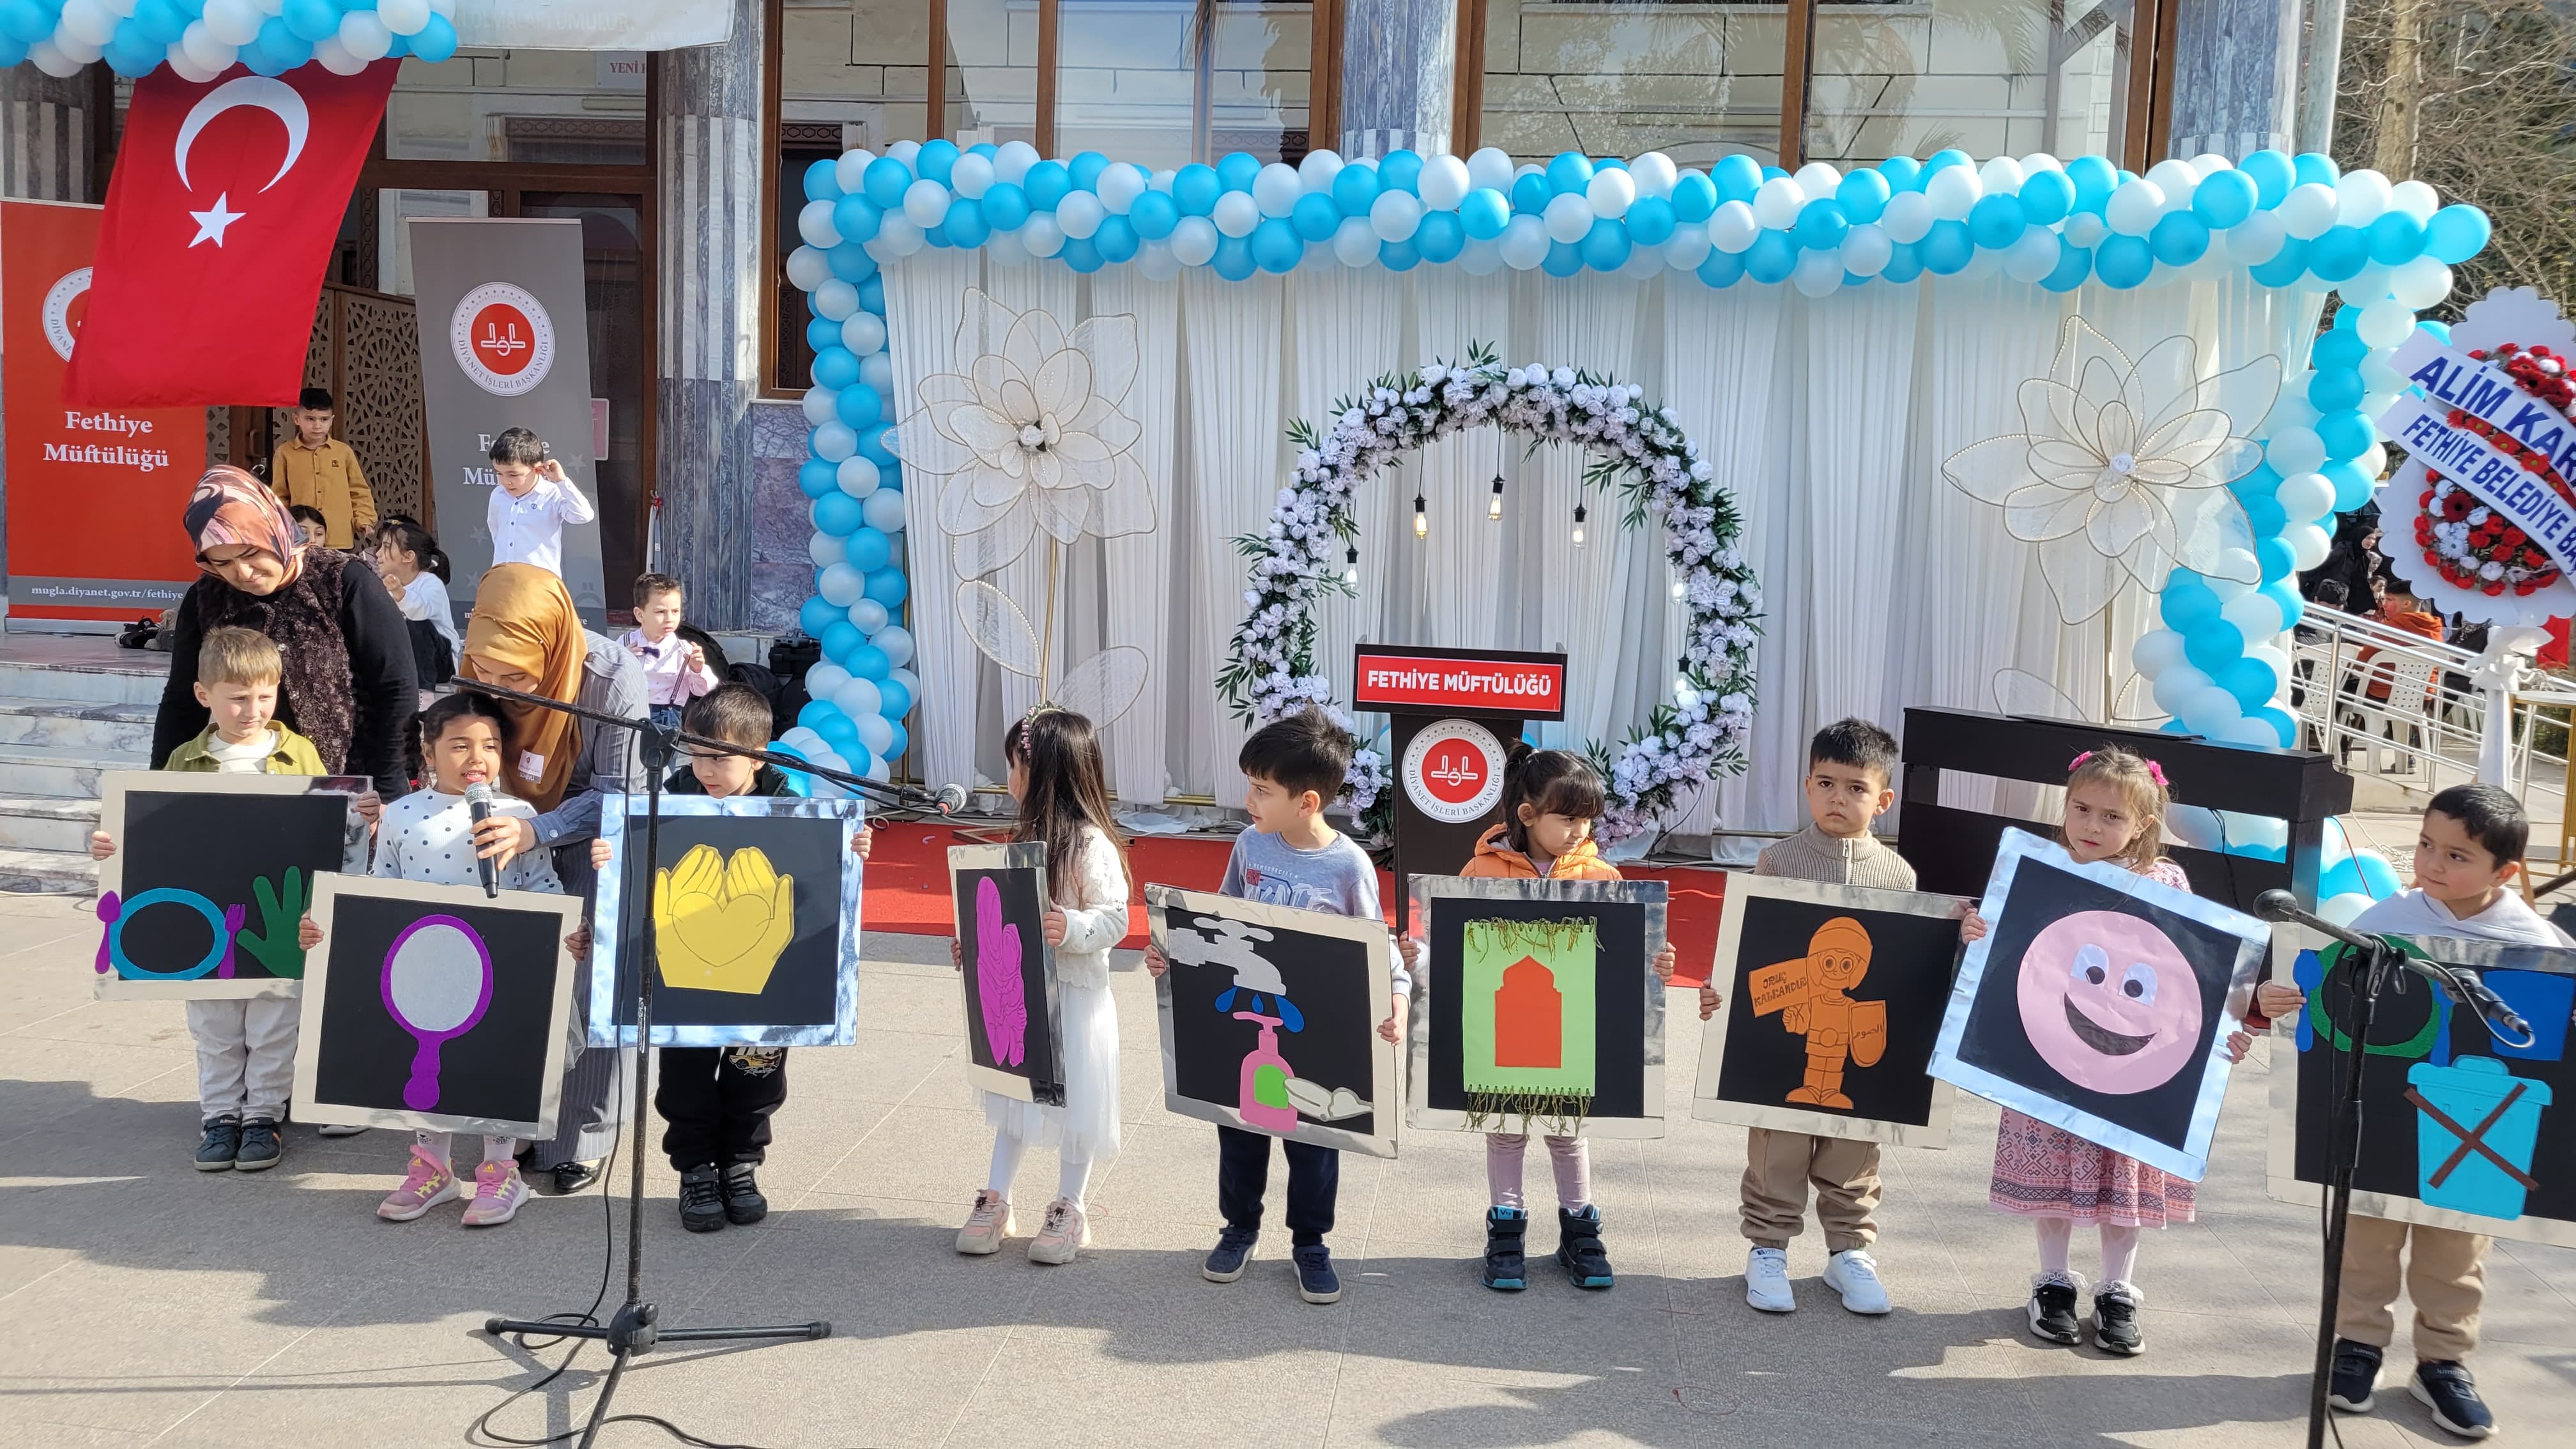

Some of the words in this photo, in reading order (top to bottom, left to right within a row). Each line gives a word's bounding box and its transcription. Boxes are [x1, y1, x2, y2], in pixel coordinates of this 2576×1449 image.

[610, 60, 638, 73] YENİ
[51, 319, 72, 353] DİYANE
[458, 340, 485, 379] DİYANET
[485, 374, 513, 389] İŞLERİ
[515, 342, 548, 387] BAŞKANLIĞI
[64, 411, 153, 438] Fethiye
[2409, 356, 2513, 419] ALİM
[2504, 402, 2576, 488] KAR
[43, 443, 169, 472] Müftülüğü
[2402, 413, 2486, 475] FETHİYE
[2470, 457, 2570, 540] BELEDİYE
[32, 586, 184, 601] mugla.diyanet.gov.tr/fethiye
[1368, 668, 1439, 691] FETHİYE
[1443, 671, 1551, 696] MÜFTÜLÜĞÜ
[1409, 770, 1431, 807] DİYANET
[1430, 802, 1460, 816] İŞLERİ
[1462, 774, 1501, 815] BAŞKANLIĞI
[1763, 971, 1788, 989] ORUÇ
